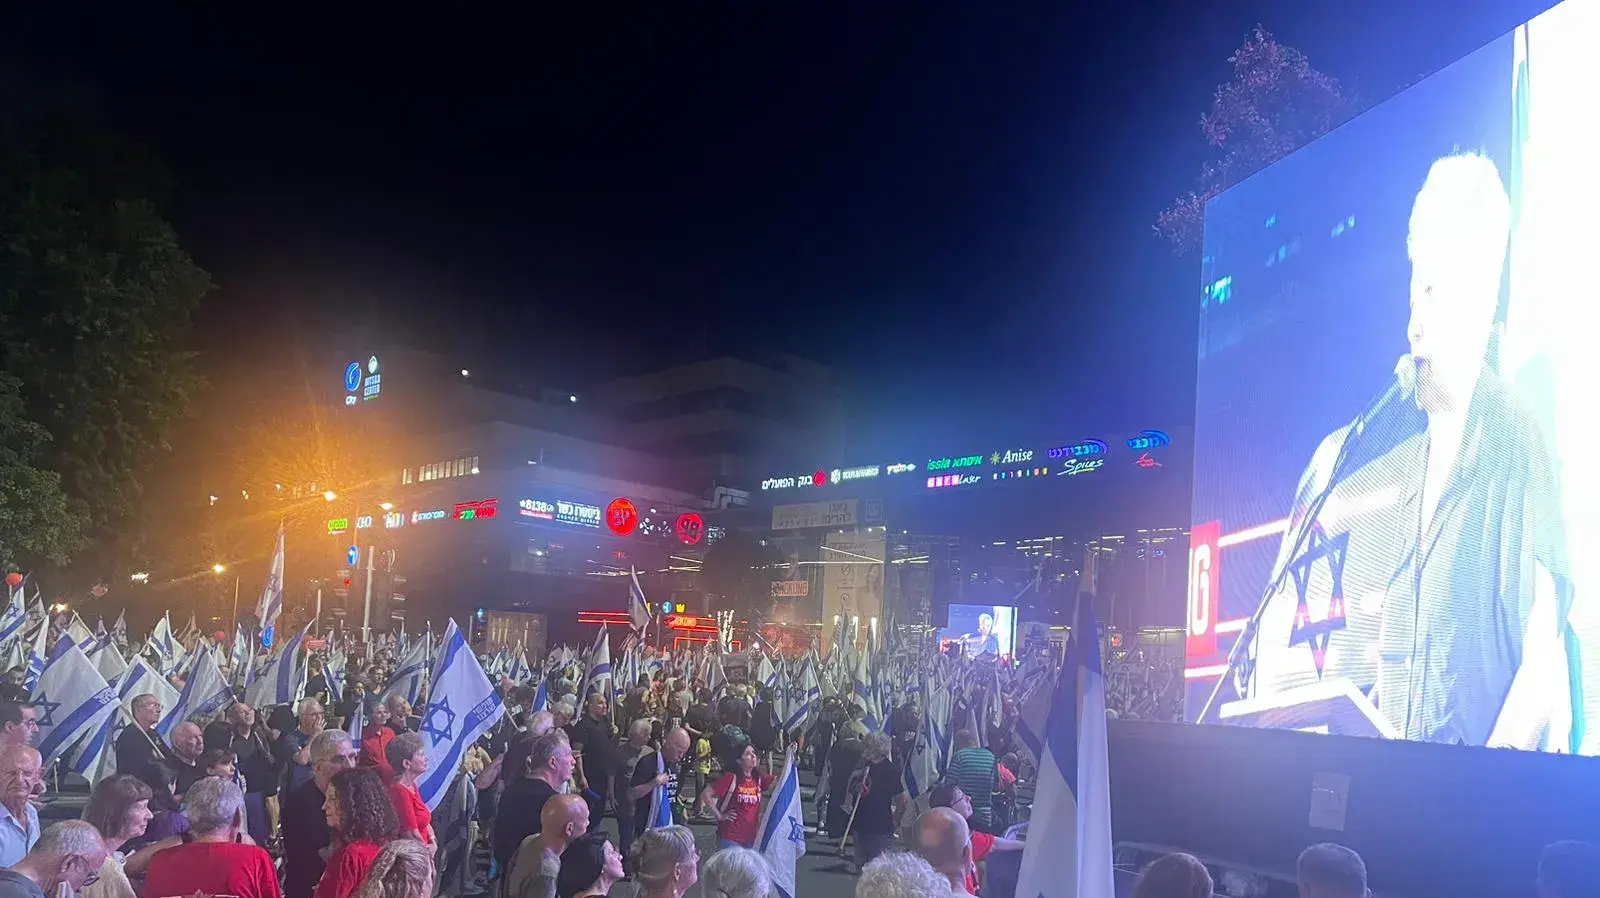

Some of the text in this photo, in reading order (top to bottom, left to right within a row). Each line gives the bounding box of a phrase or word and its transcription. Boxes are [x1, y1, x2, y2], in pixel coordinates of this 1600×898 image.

[1002, 448, 1033, 464] Anise
[1057, 458, 1104, 475] Spices
[762, 475, 813, 490] בנק הפועלים
